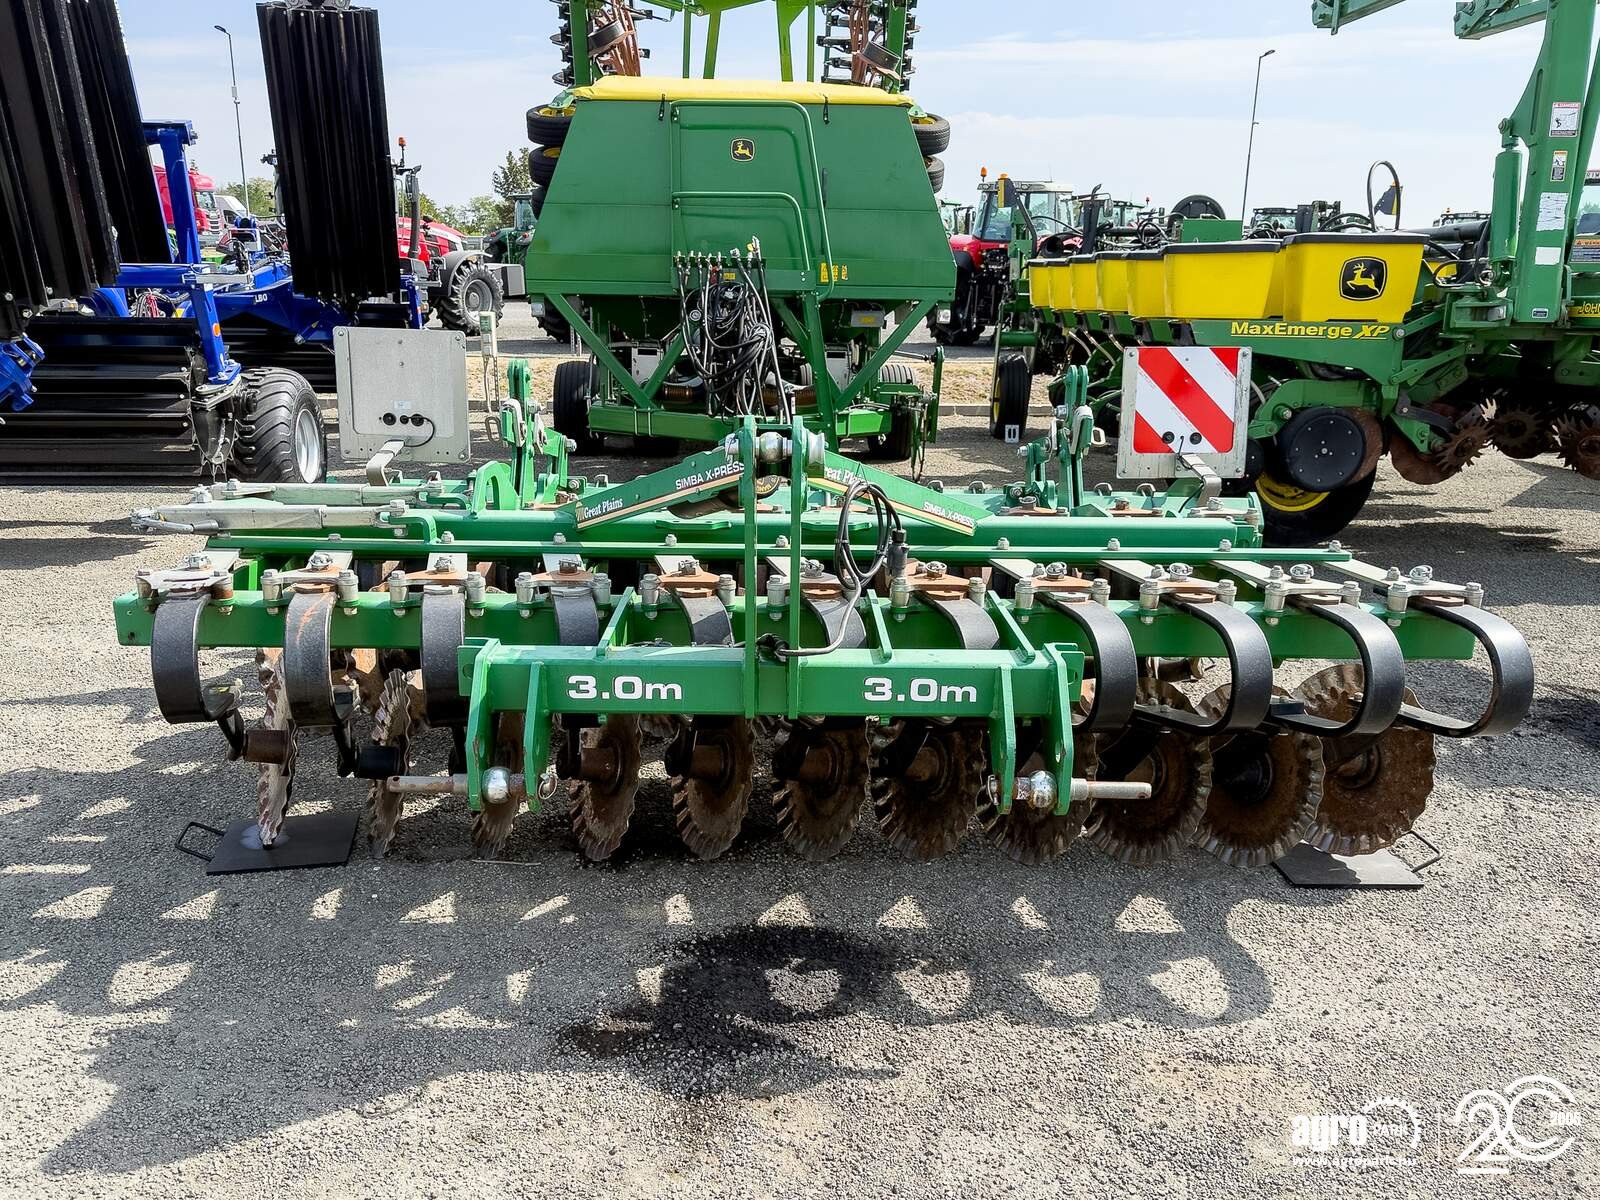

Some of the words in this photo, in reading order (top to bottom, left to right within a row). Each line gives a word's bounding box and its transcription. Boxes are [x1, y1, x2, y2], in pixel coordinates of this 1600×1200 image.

[1578, 301, 1600, 314] JOH
[1231, 321, 1352, 339] MaxEmerge
[1353, 324, 1390, 339] XP
[675, 472, 704, 490] SIMBA
[824, 466, 842, 480] reat
[584, 503, 601, 519] Great
[602, 498, 623, 515] Plains
[924, 501, 946, 517] SIMBA
[567, 675, 682, 700] 3.0m
[863, 677, 977, 702] 3.0m
